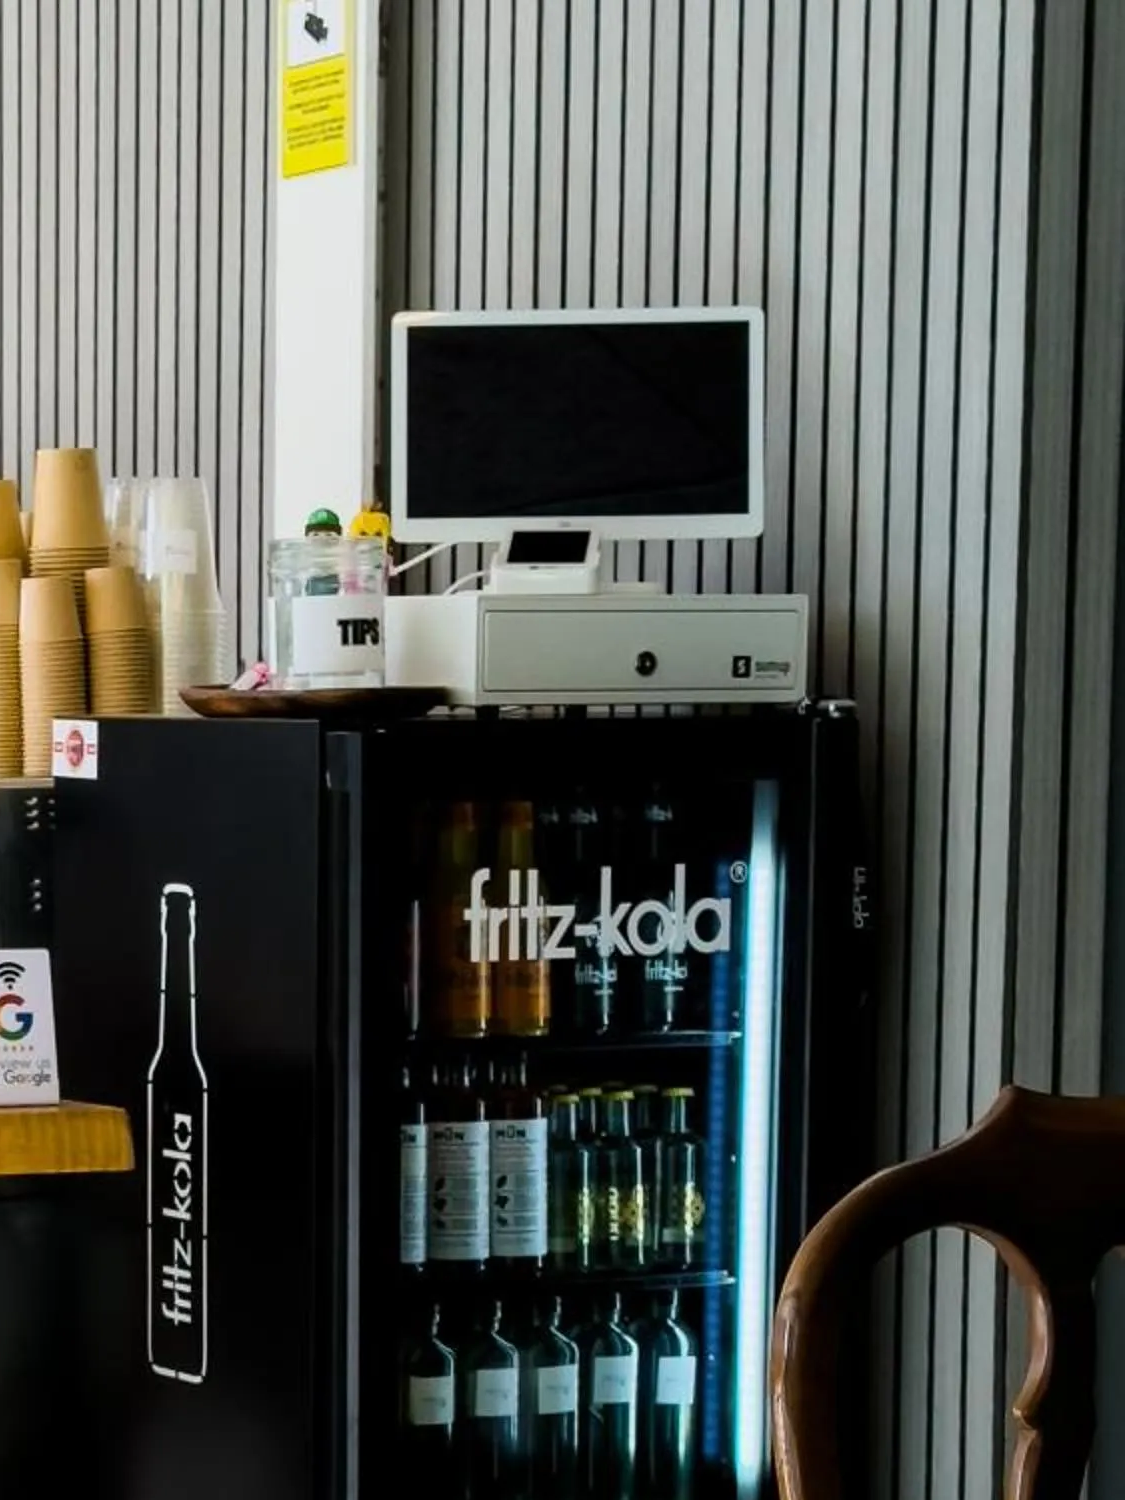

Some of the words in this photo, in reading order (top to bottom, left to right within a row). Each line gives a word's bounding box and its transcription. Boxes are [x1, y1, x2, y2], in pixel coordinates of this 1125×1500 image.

[337, 617, 381, 647] TIPS
[37, 1058, 52, 1069] us
[3, 1069, 52, 1087] Google
[161, 1112, 193, 1327] fritz-kola
